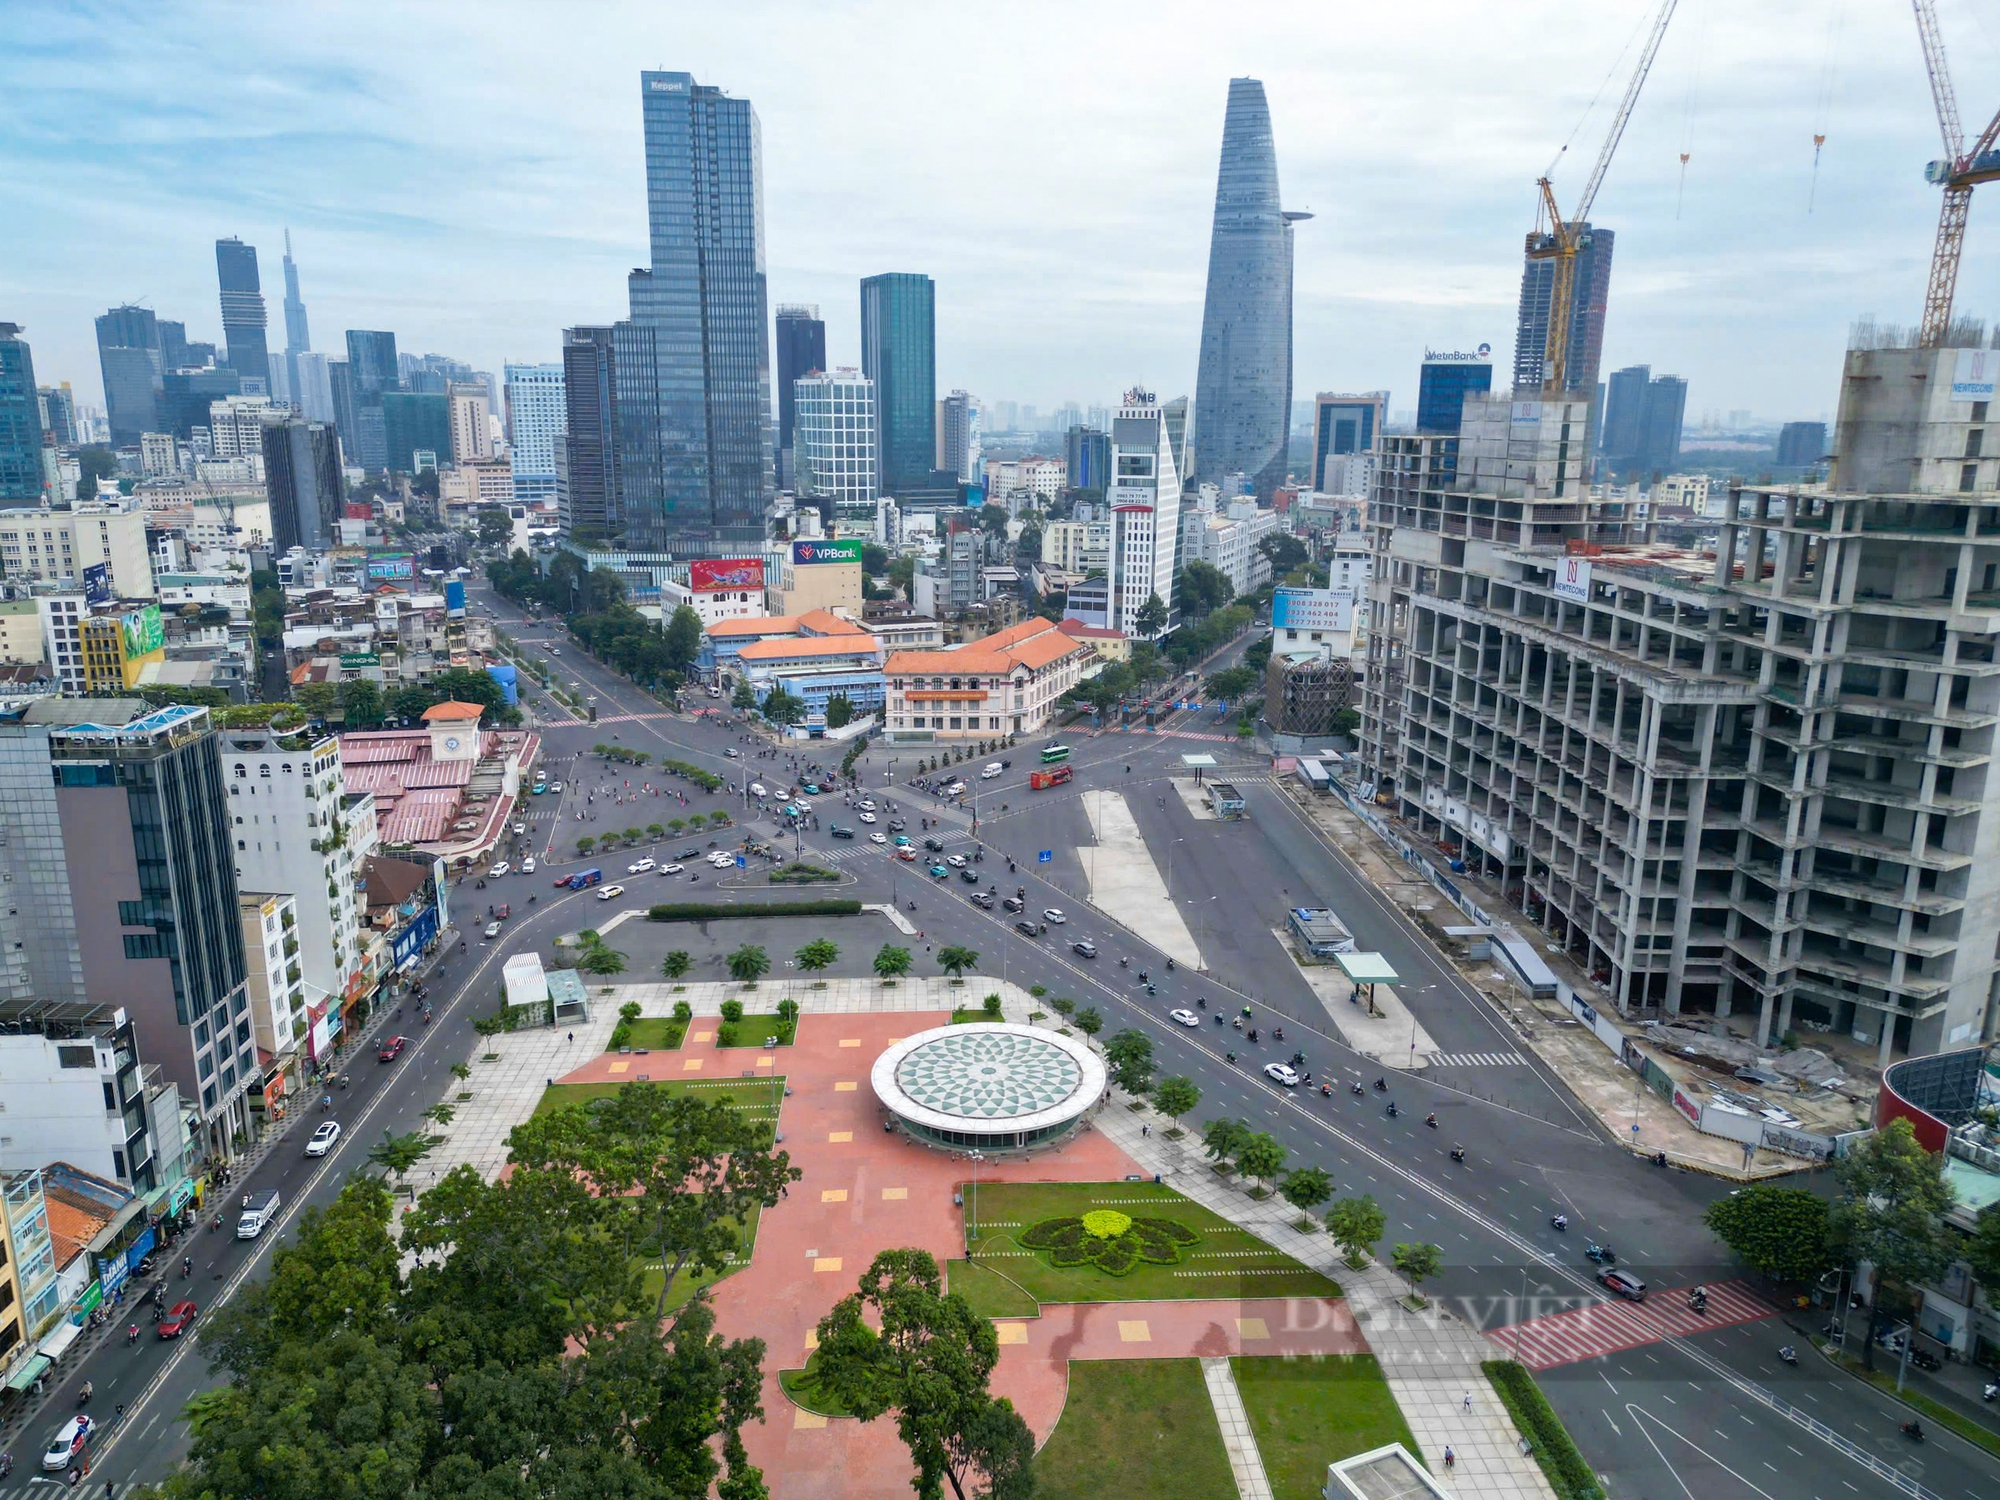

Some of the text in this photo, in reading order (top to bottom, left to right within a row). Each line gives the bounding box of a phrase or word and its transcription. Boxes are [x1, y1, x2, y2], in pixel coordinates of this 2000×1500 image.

[651, 81, 683, 91] Keppel
[1953, 383, 1994, 393] NEWTECONS
[1137, 393, 1156, 403] MB
[816, 548, 856, 559] VPBank
[1555, 582, 1586, 597] NEWTECONS
